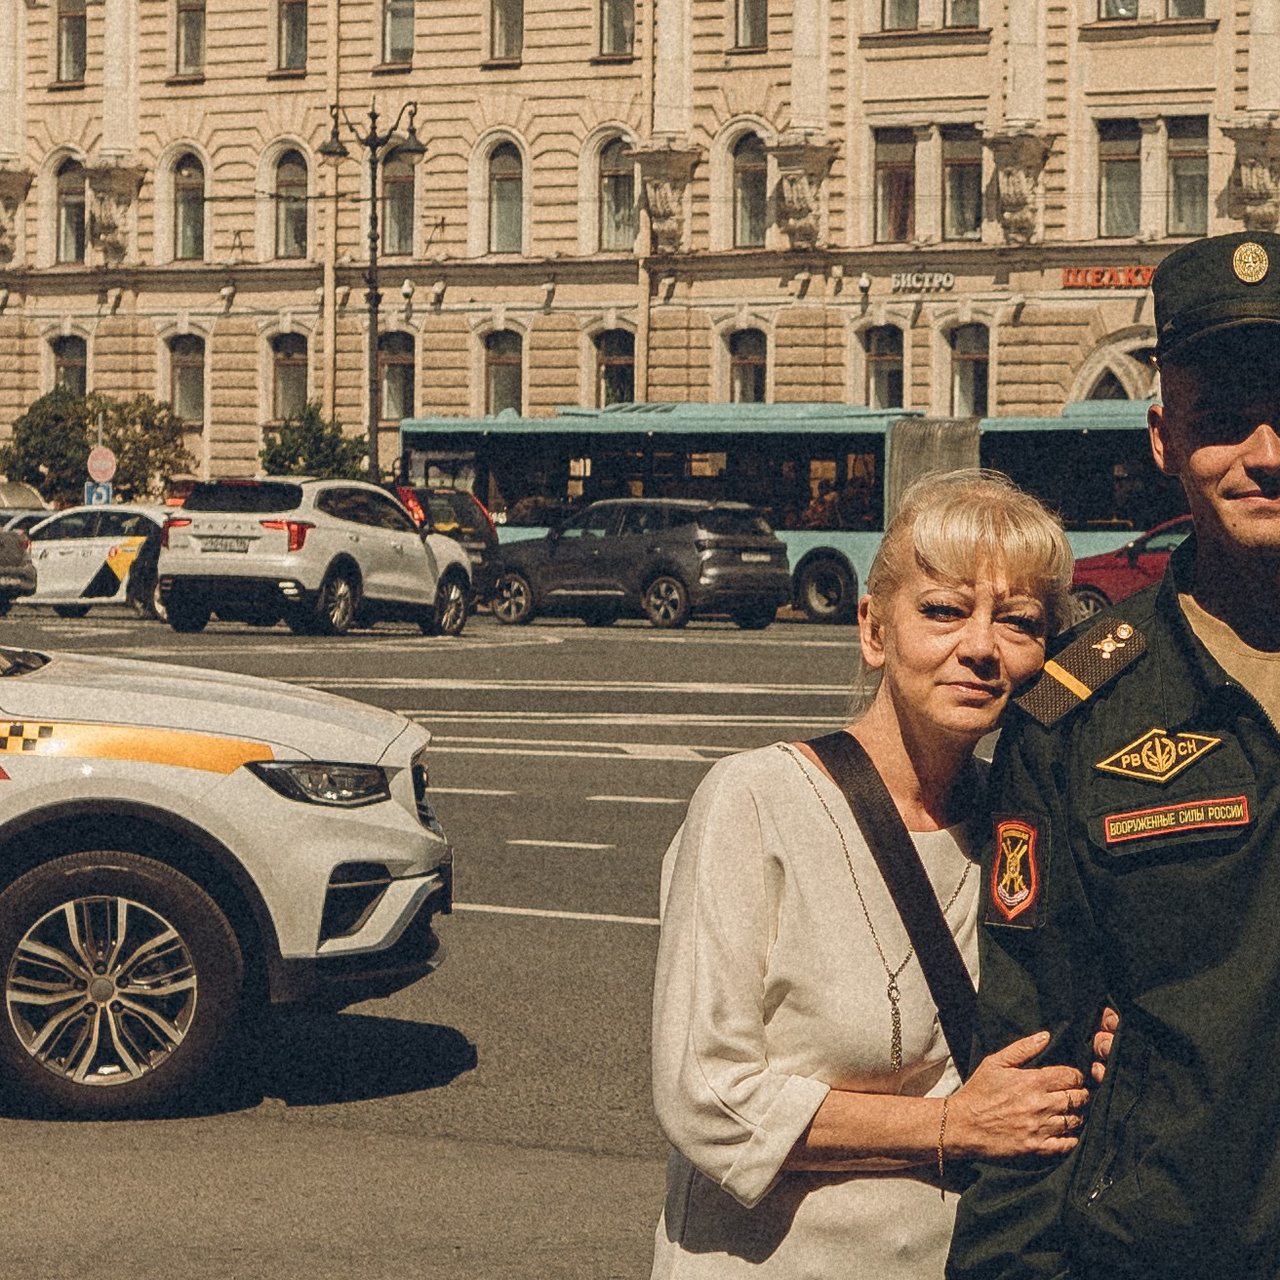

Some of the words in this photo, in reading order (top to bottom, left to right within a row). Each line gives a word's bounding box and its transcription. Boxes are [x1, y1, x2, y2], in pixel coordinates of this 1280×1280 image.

[891, 272, 955, 292] БИСТРО
[1121, 753, 1141, 768] РВ
[1177, 739, 1197, 756] СН
[1109, 812, 1176, 836] ВООРУЖЕННЫЕ
[1179, 807, 1205, 824] СИЛЫ
[1208, 803, 1244, 820] РОССИИ
